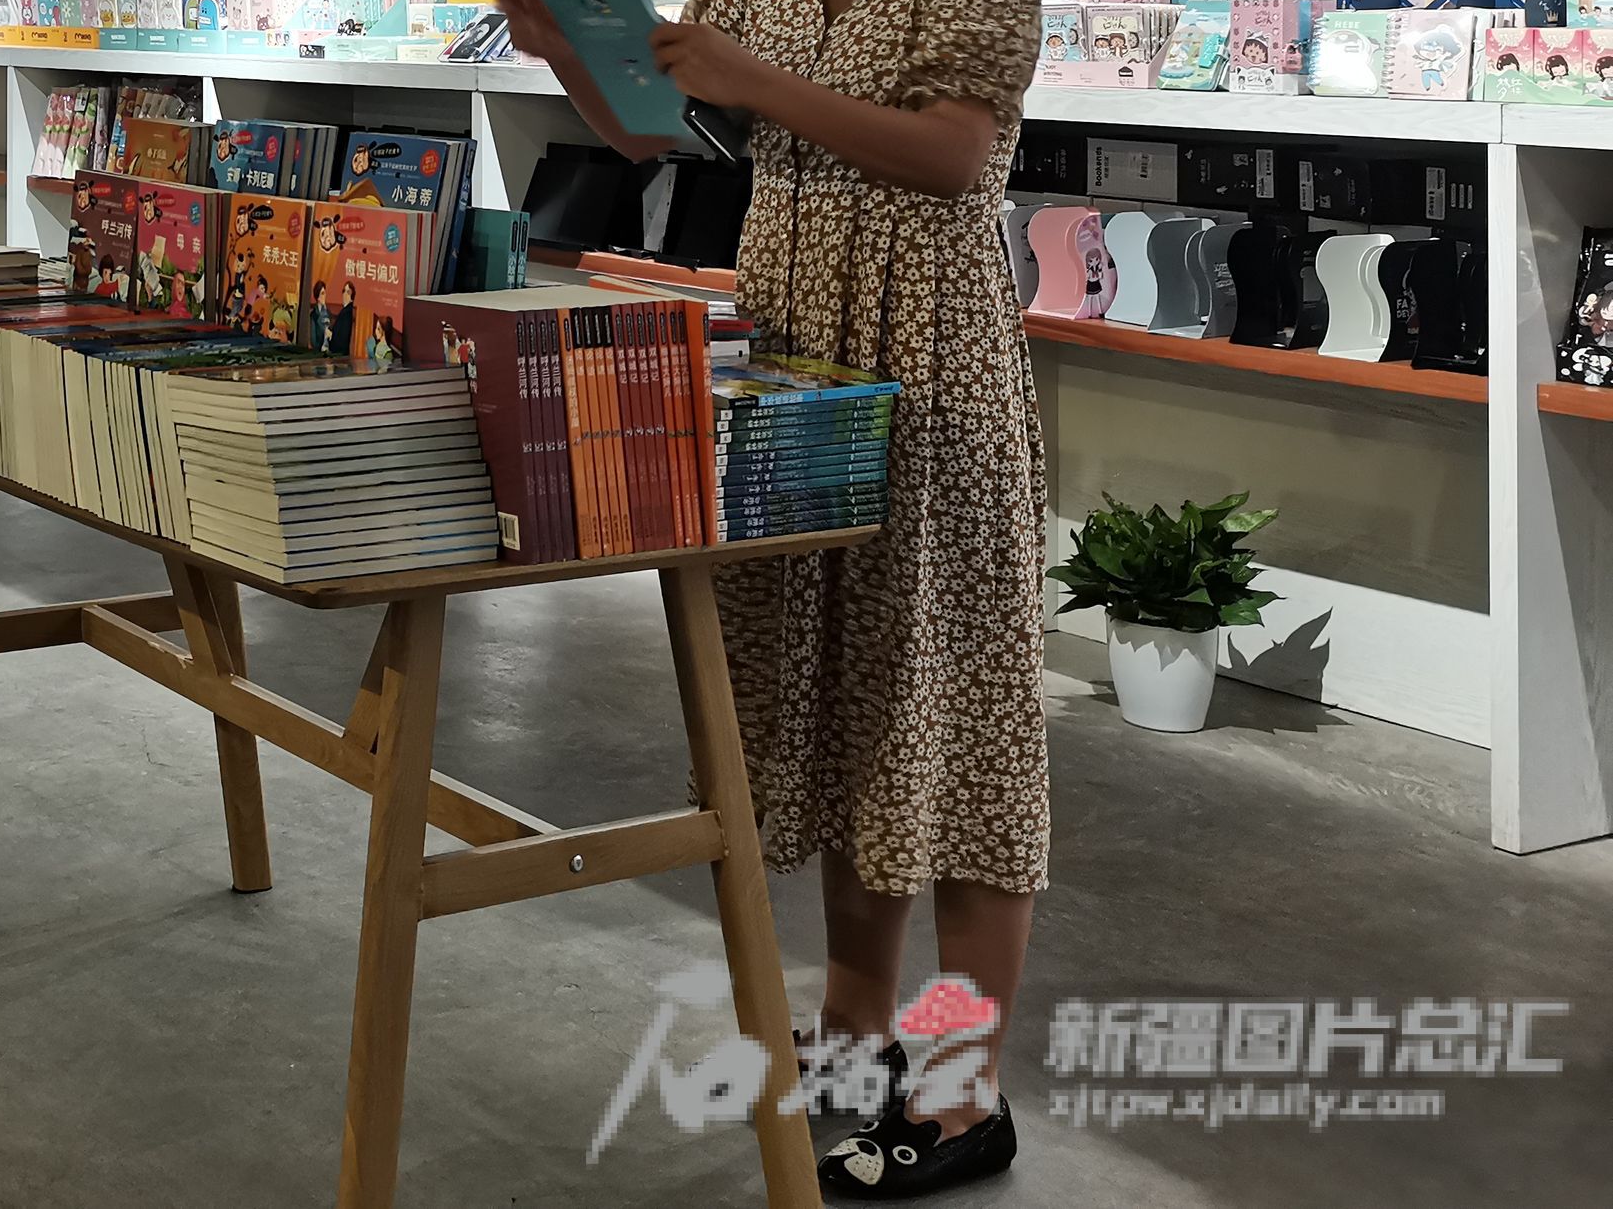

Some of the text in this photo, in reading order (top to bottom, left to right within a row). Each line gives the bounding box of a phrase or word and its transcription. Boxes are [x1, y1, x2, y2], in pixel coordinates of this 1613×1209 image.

[391, 184, 433, 207] 小海蒂
[101, 219, 133, 240] 呼兰河传
[262, 245, 299, 268] 秃秃大王
[345, 258, 400, 285] 傲慢与偏见
